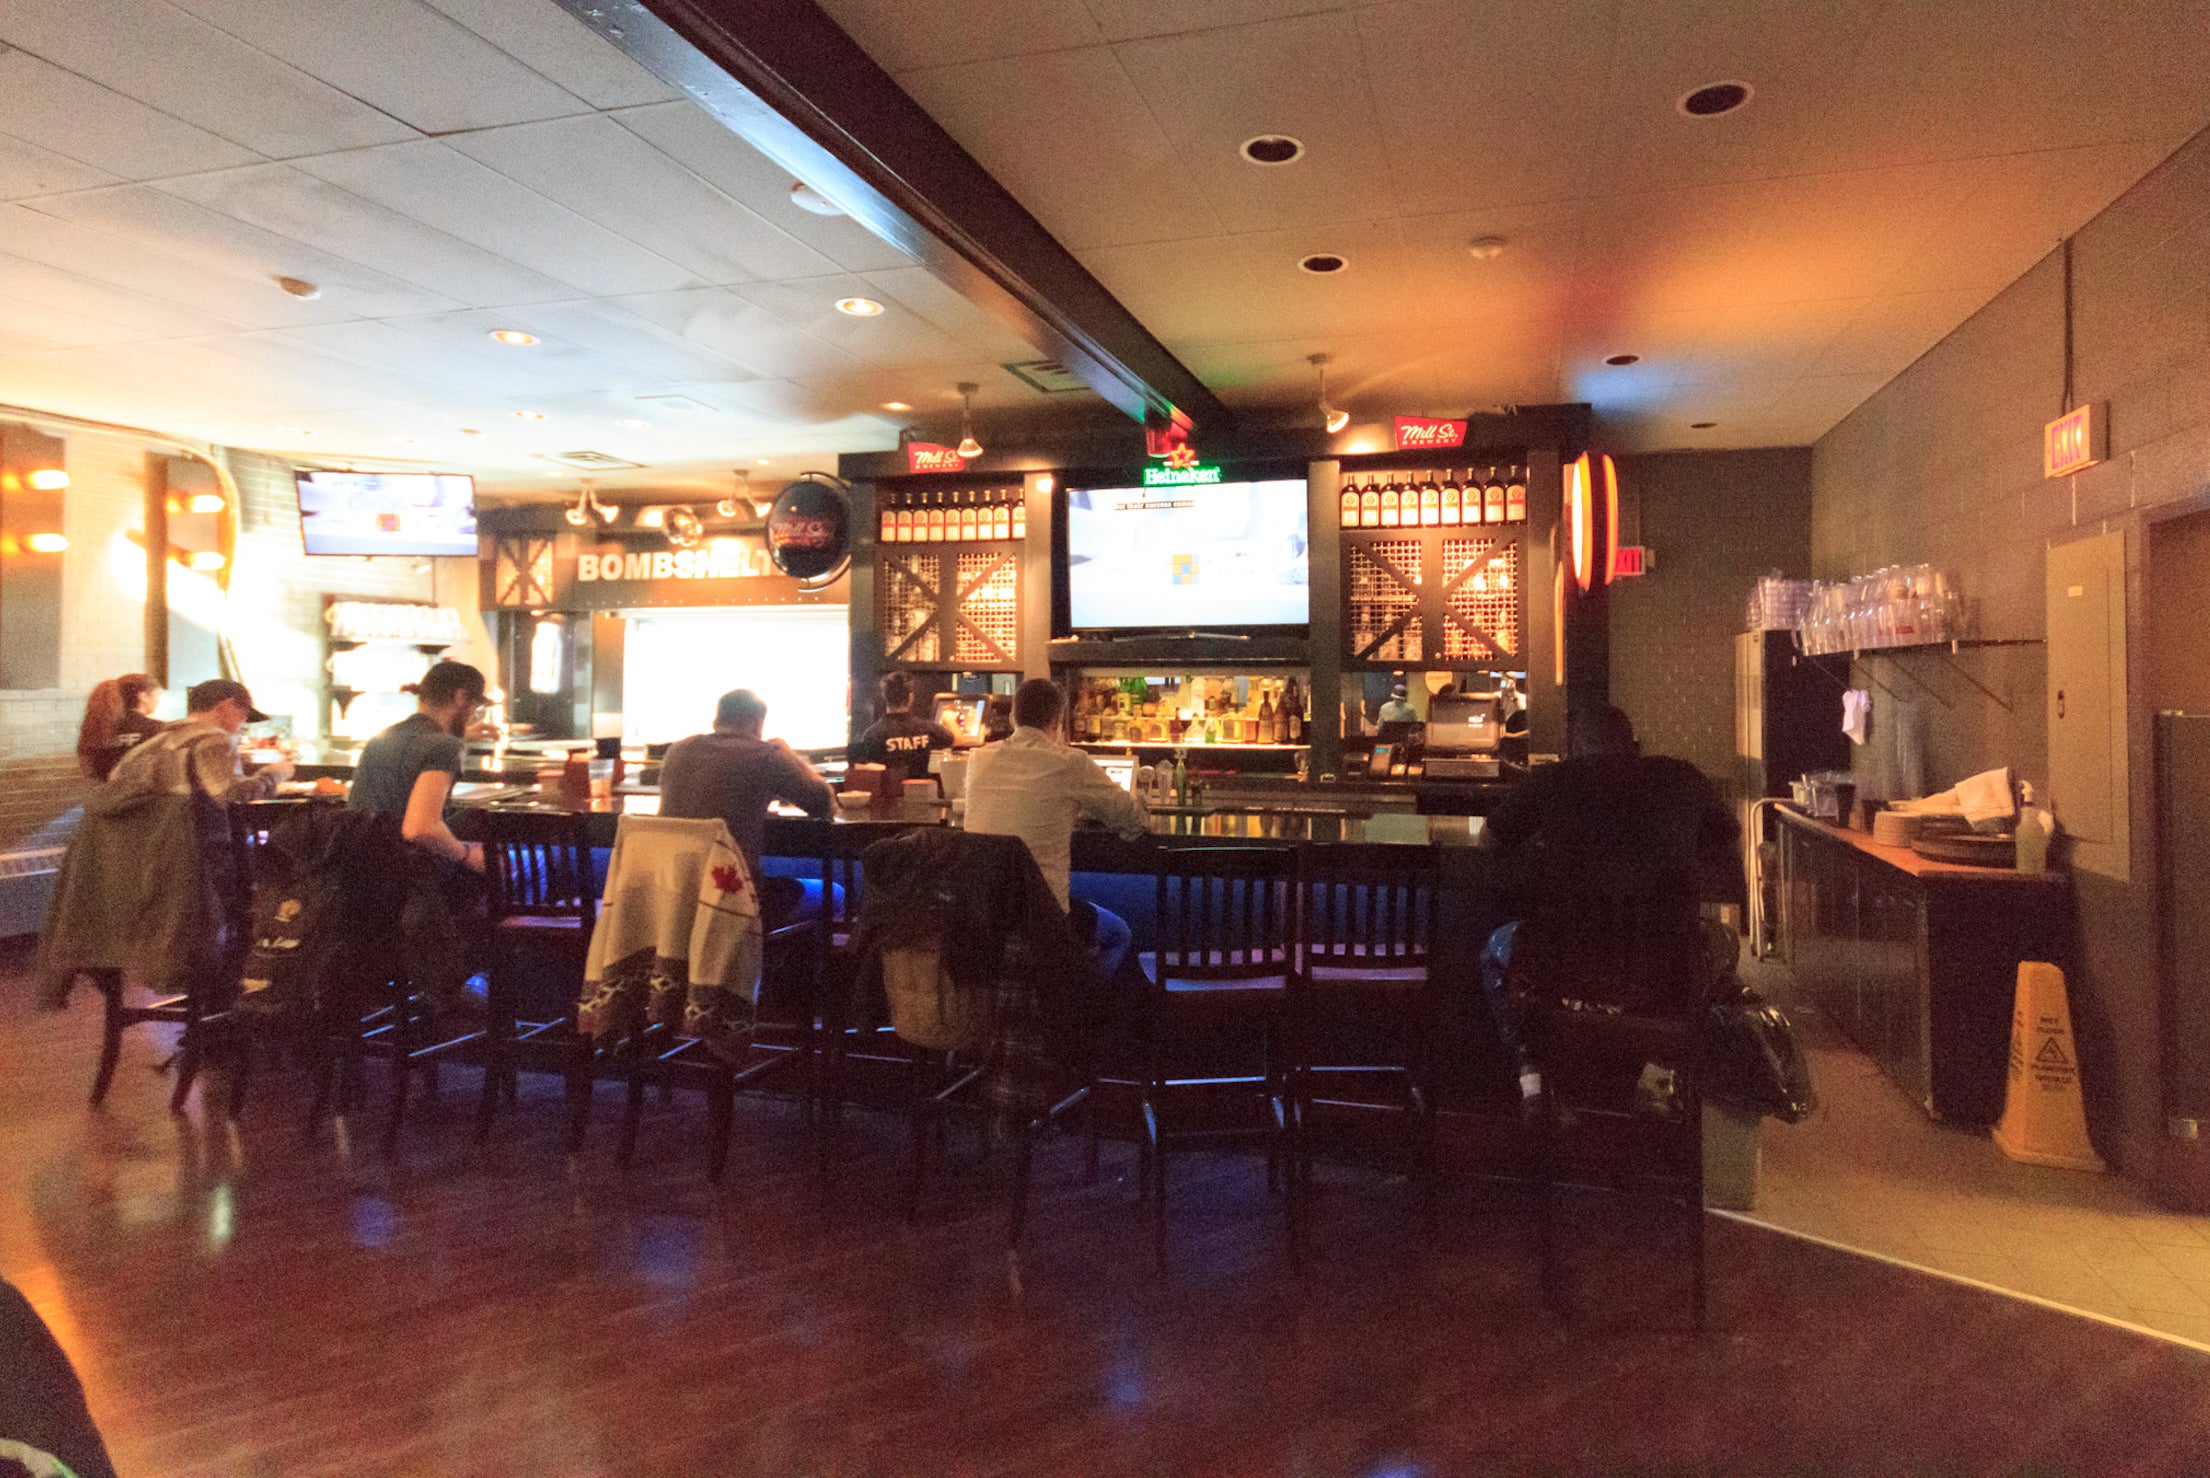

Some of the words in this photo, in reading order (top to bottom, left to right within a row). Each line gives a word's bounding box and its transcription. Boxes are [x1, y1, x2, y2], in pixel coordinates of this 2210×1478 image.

[1400, 424, 1438, 440] Mill
[2051, 413, 2083, 470] EXIT
[914, 450, 944, 465] Mill
[1145, 467, 1220, 485] Heineken
[578, 549, 787, 581] BOMBSHELT
[1616, 550, 1641, 572] XIT
[885, 734, 930, 752] STAFF
